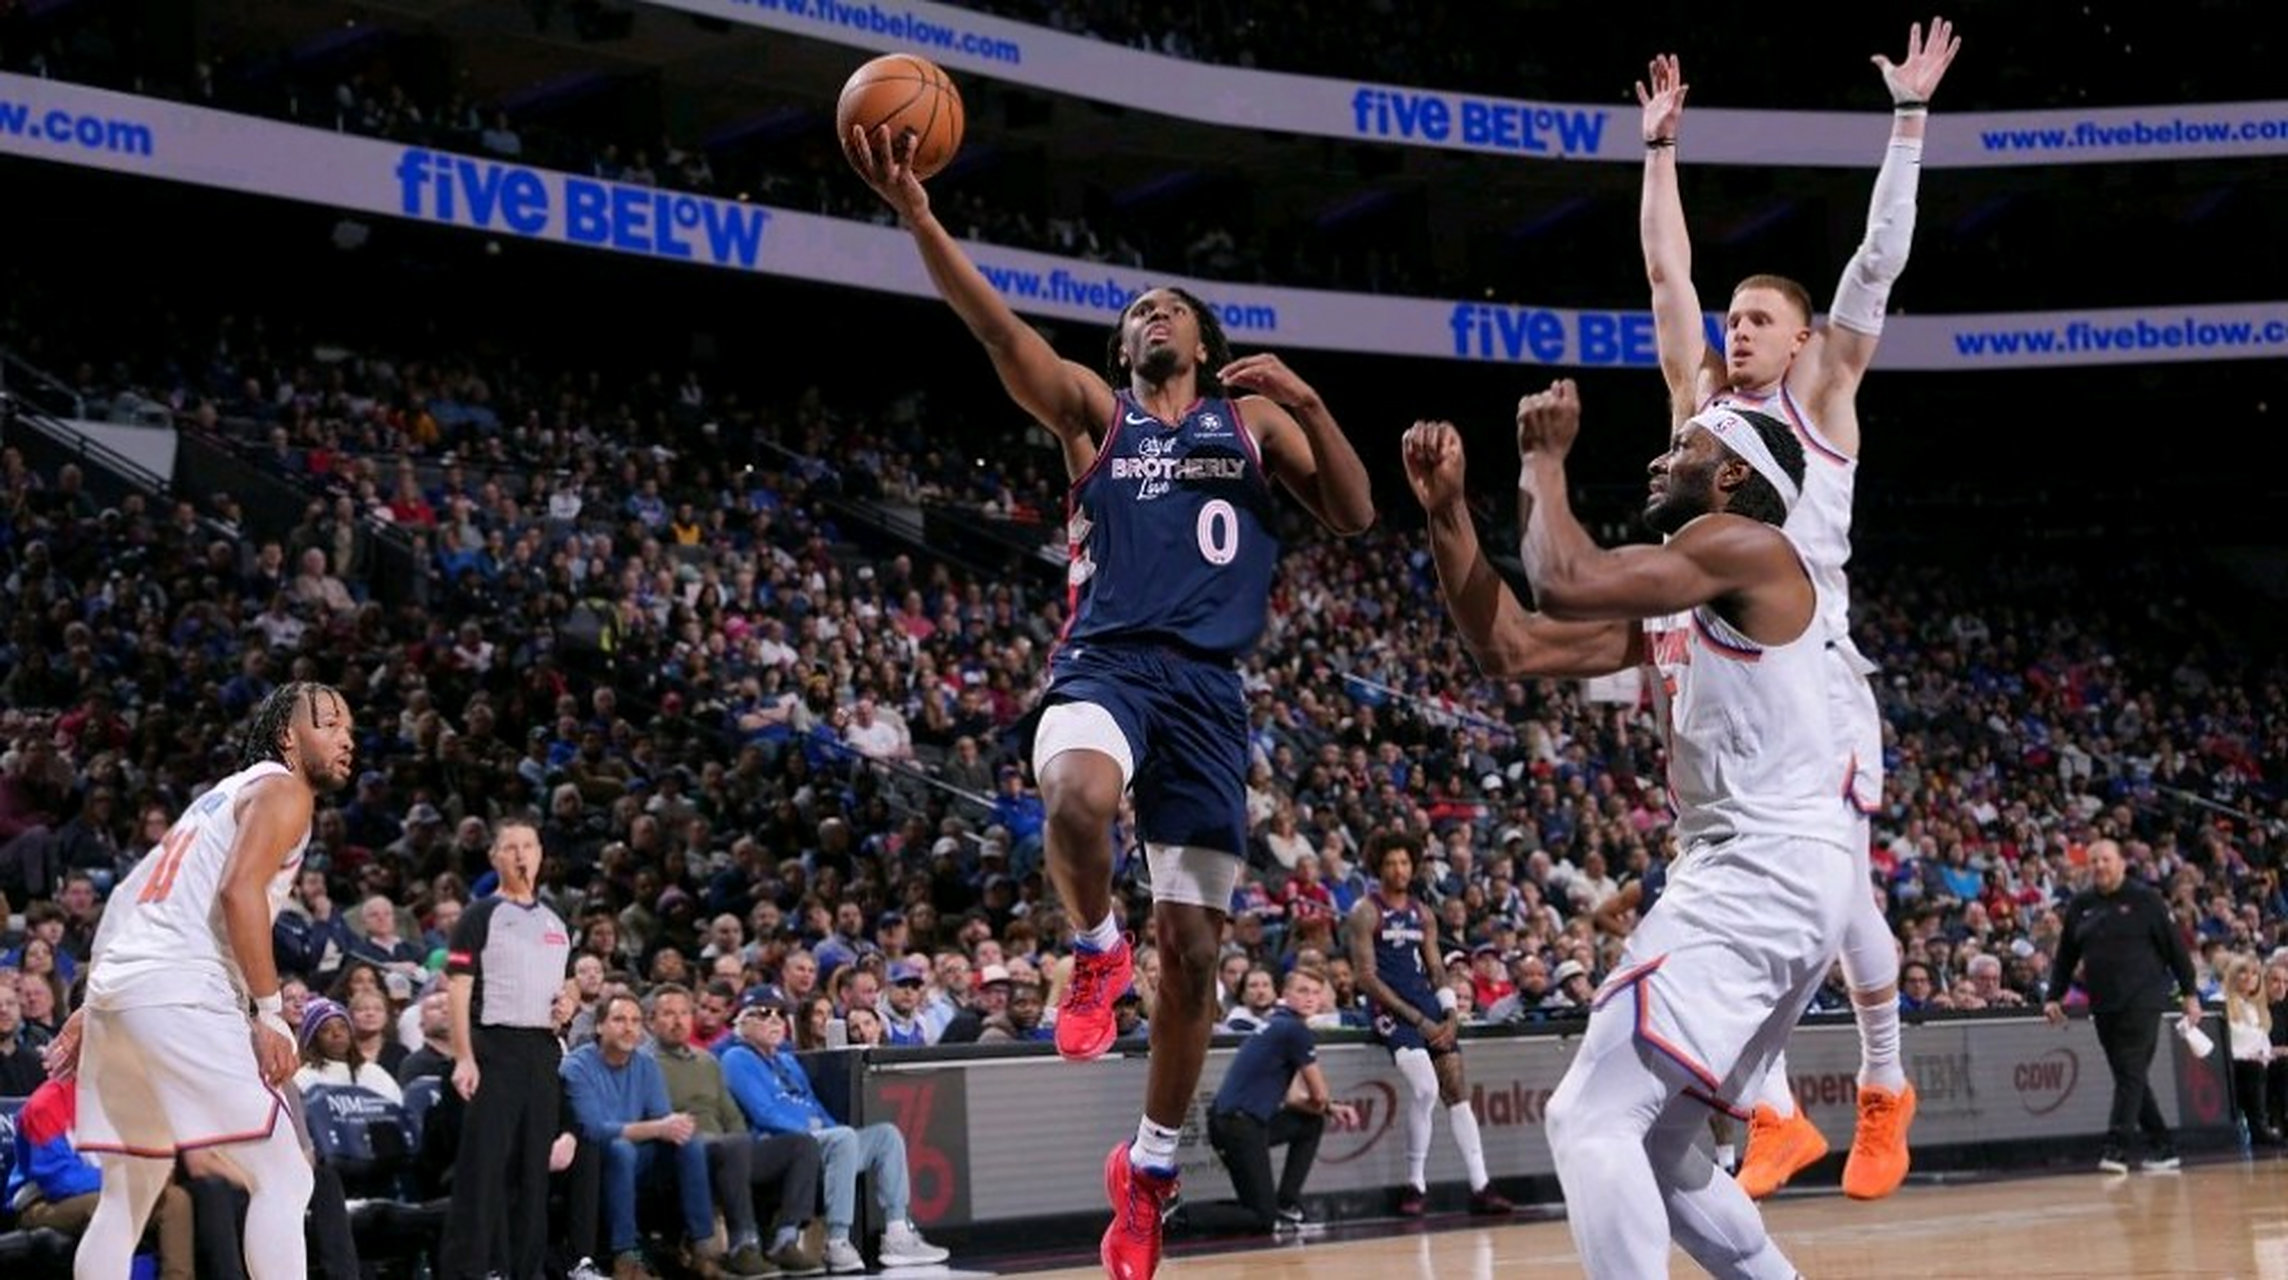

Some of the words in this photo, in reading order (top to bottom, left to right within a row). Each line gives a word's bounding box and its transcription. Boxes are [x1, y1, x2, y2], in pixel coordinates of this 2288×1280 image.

[729, 0, 1020, 63] w.fivebelow.com
[1955, 318, 2288, 355] www.fivebelow.c
[1111, 457, 1246, 481] BROTHERLY
[1197, 499, 1239, 566] 0
[1786, 1072, 1858, 1109] pen
[2014, 1062, 2065, 1093] CDW
[326, 1094, 364, 1117] NJM
